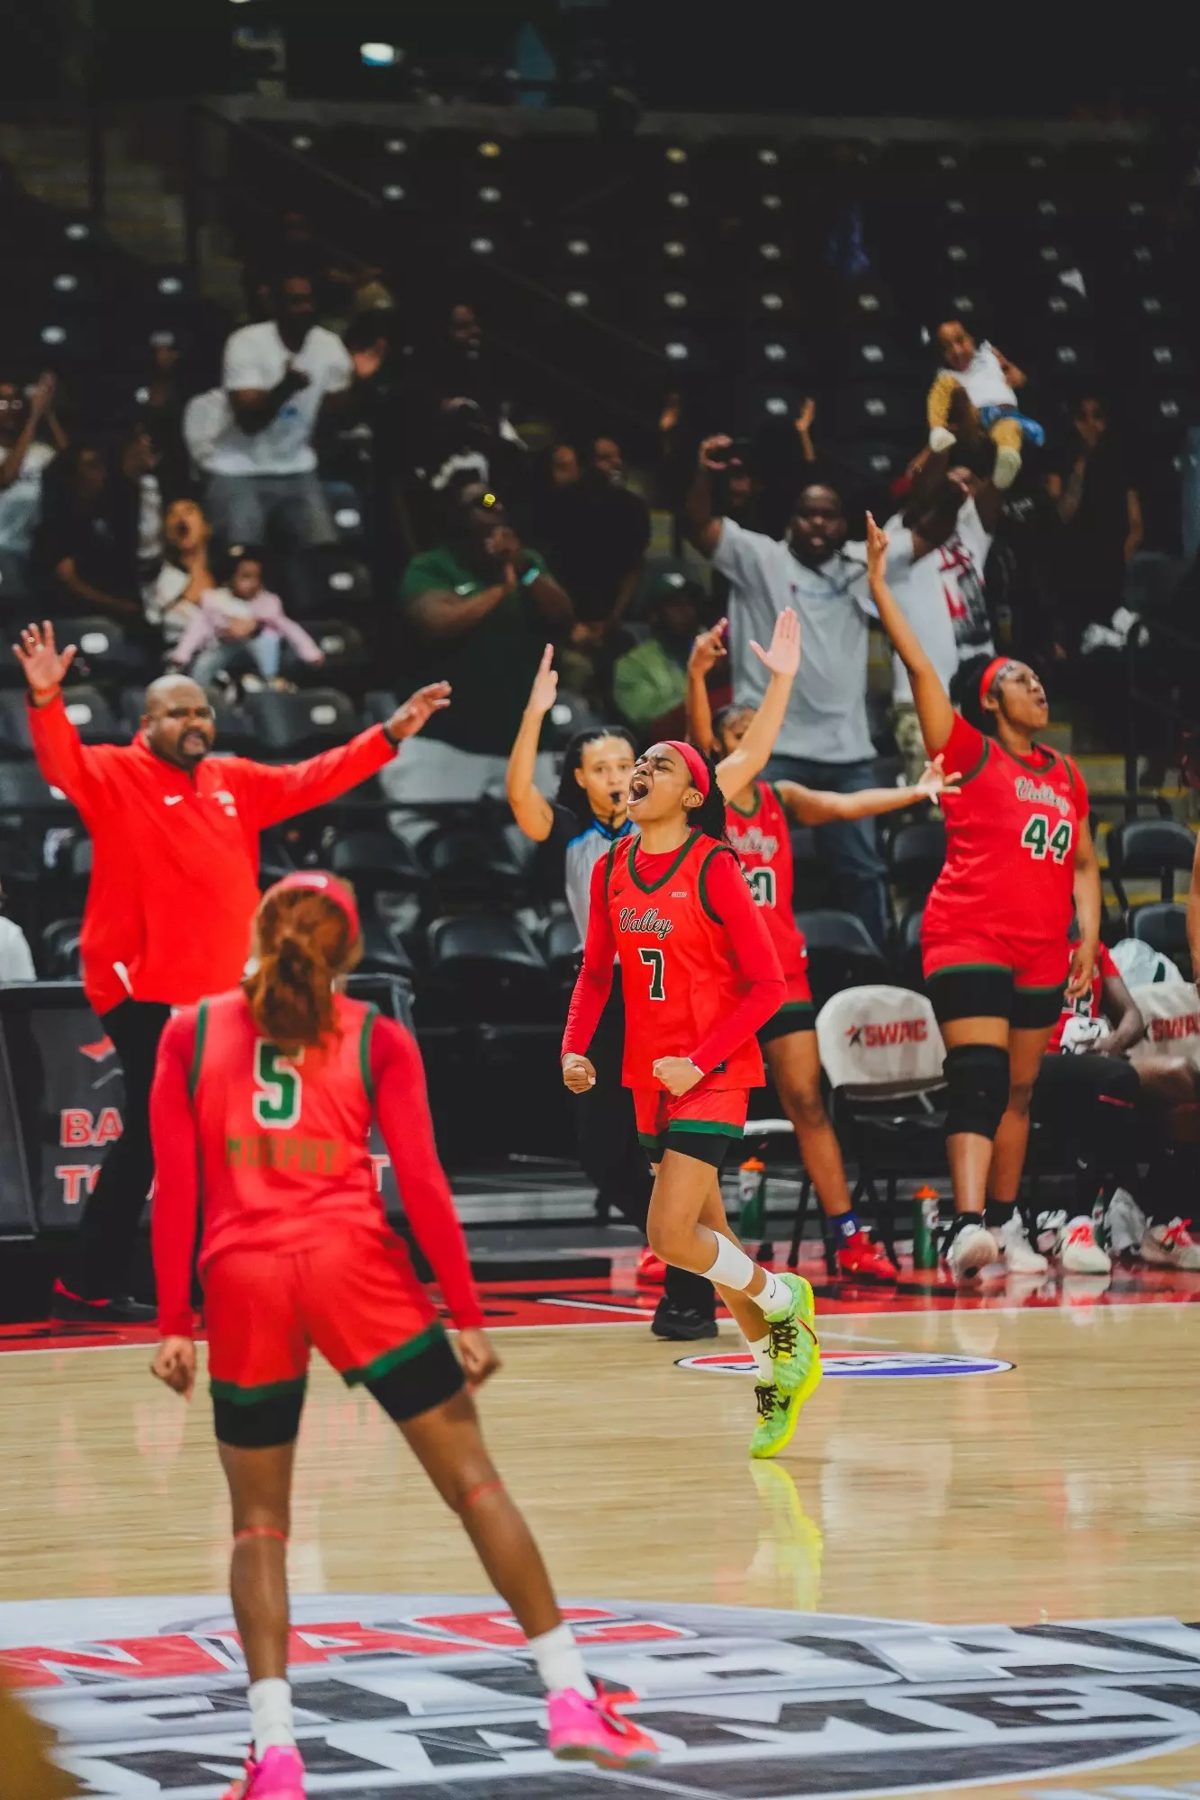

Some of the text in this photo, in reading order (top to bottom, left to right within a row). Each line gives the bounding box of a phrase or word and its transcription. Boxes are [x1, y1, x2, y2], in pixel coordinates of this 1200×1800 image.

[1020, 813, 1072, 865] 44
[619, 907, 674, 940] Valley
[637, 947, 666, 1001] 7
[862, 1016, 929, 1049] SWAC
[252, 1038, 304, 1130] 5
